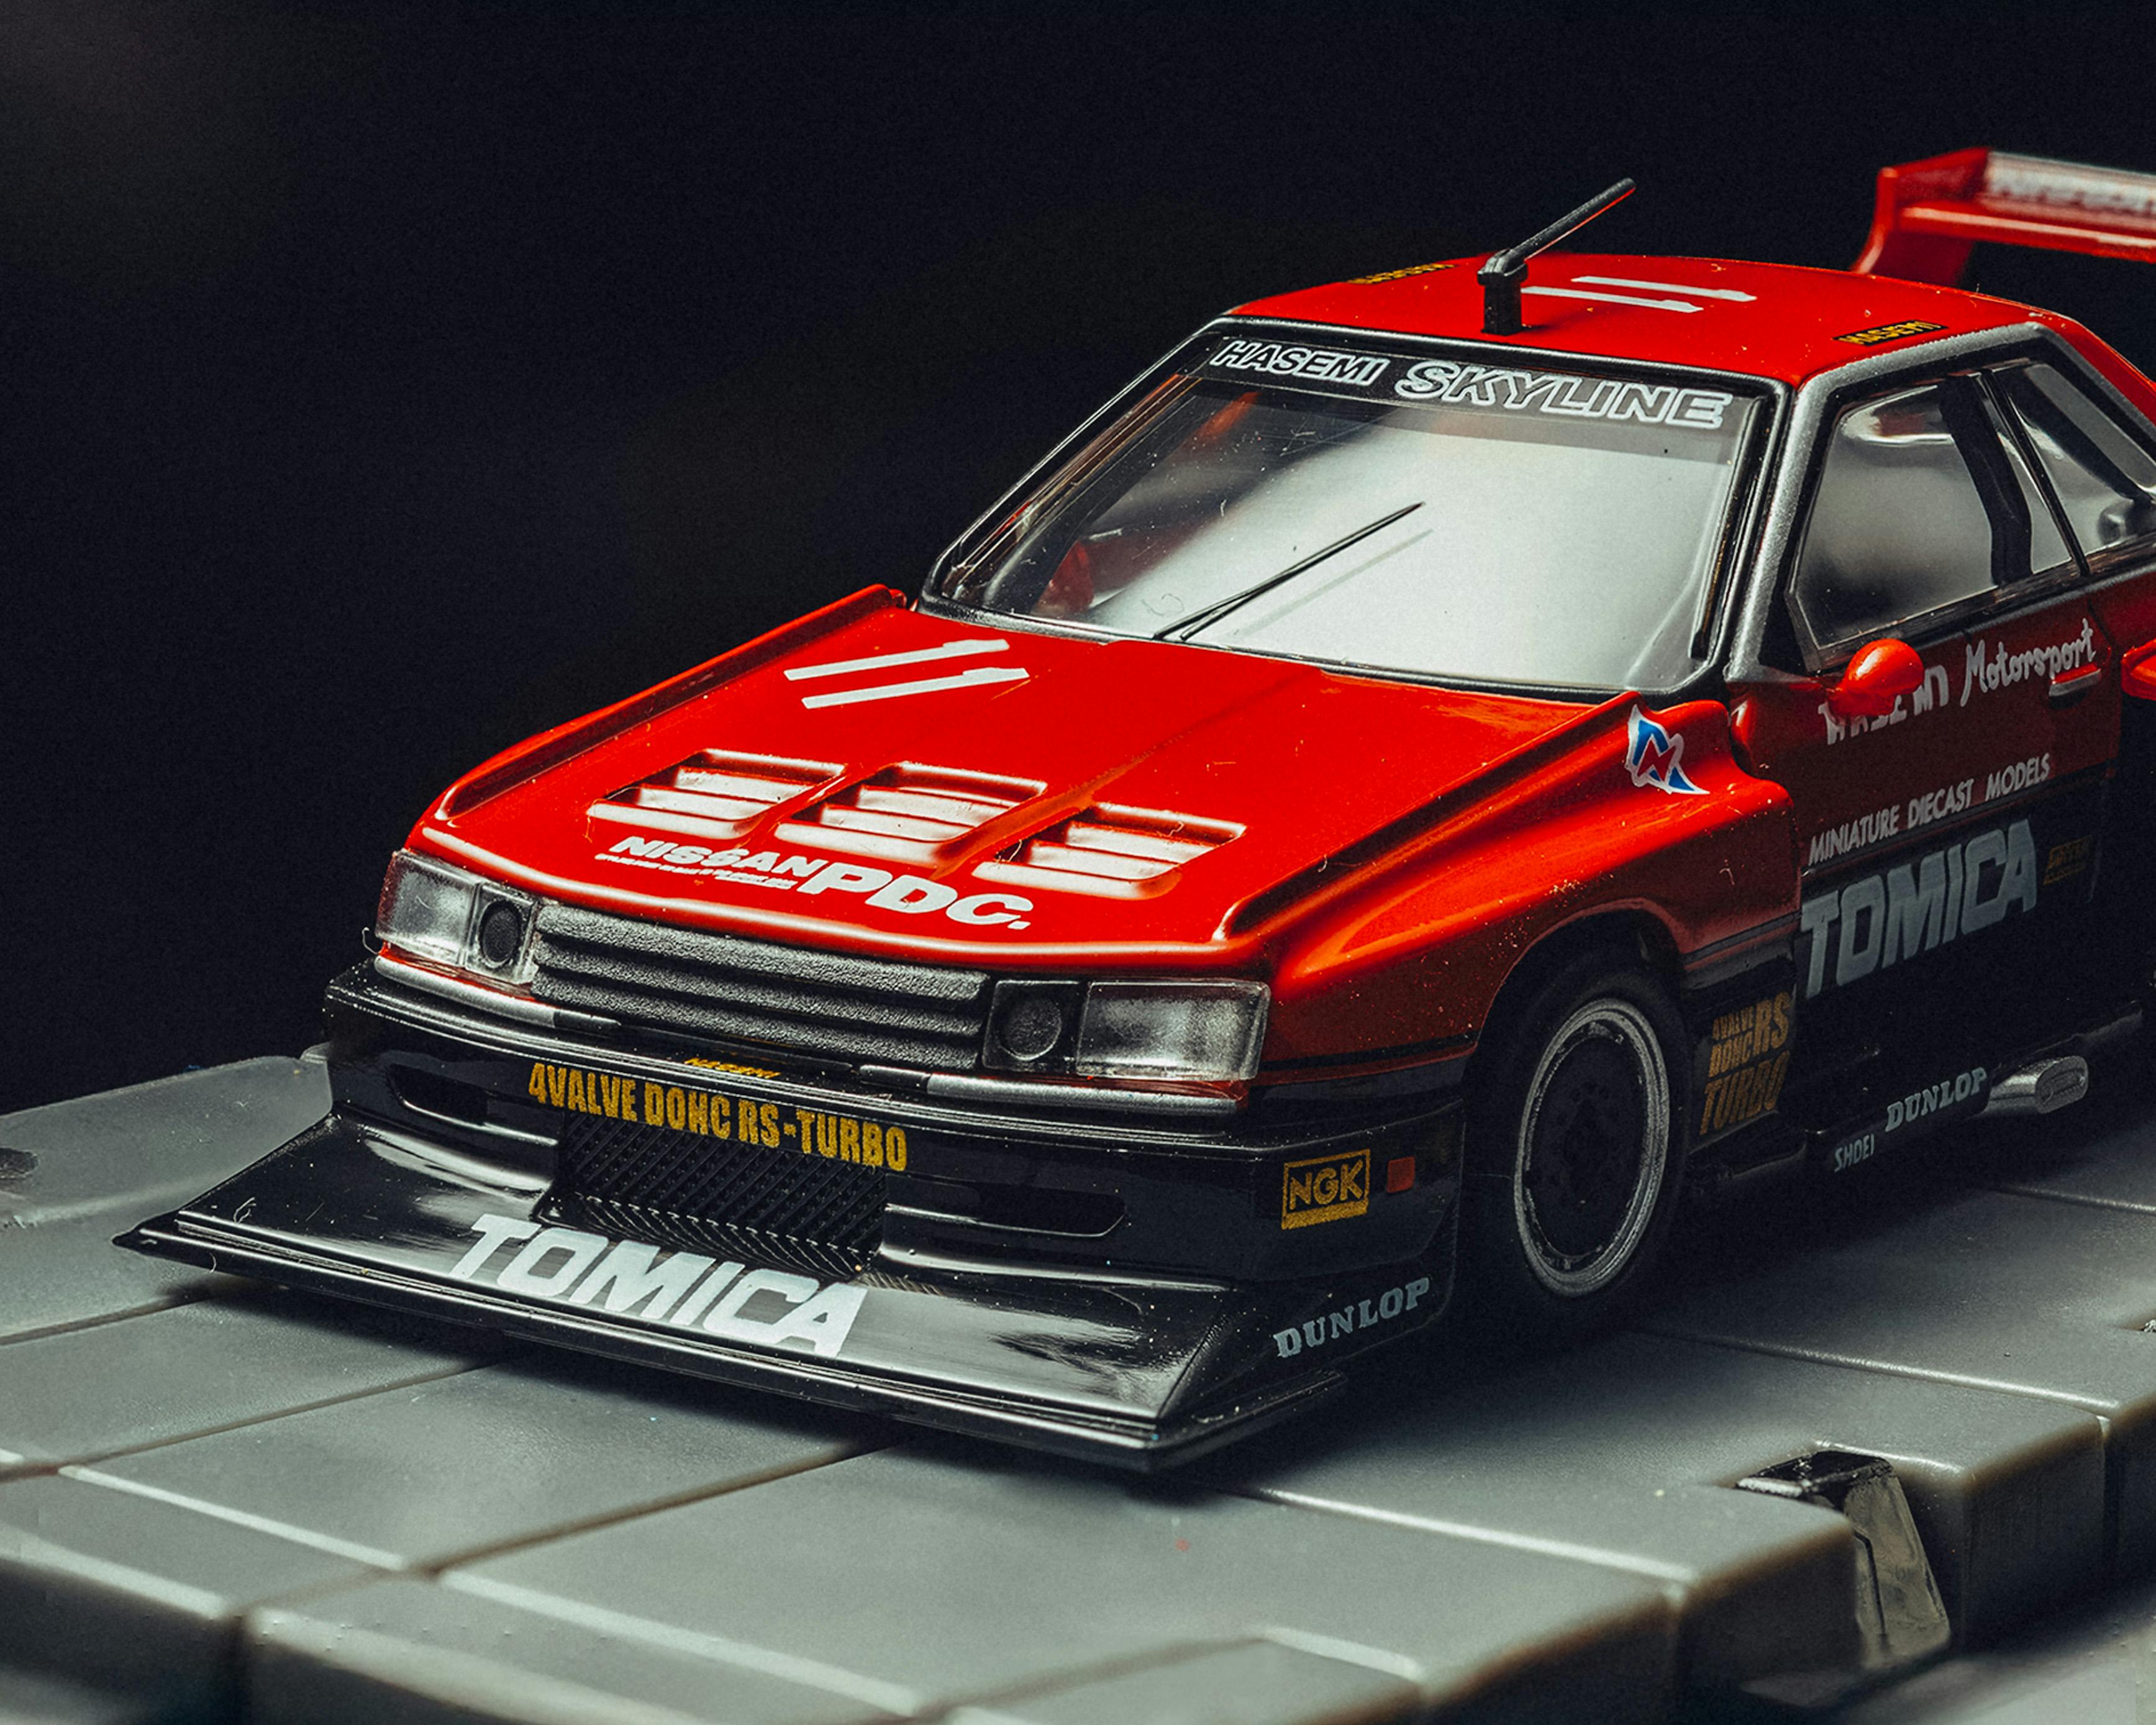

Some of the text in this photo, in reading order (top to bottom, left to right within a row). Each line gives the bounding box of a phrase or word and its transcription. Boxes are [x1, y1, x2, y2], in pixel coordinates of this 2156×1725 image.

[1209, 340, 1733, 429] HASEMI SKYLINE
[1960, 617, 2096, 707] Motorsport
[1808, 752, 2050, 866] MINIATURE DIECAST MODELS
[608, 835, 828, 879] NISSAN
[1801, 819, 2037, 999] TOMICA
[1753, 992, 1791, 1055] RS
[528, 1062, 637, 1122] 4VALVE
[644, 1082, 730, 1140] DOHC
[1699, 1050, 1791, 1136] TURBO
[1885, 1067, 1988, 1132] DUNLOP
[1289, 1158, 1364, 1211] NGK
[1834, 1134, 1875, 1172] SHOEI
[448, 1213, 868, 1359] TOMICA
[1273, 1277, 1429, 1359] DUNLOP
